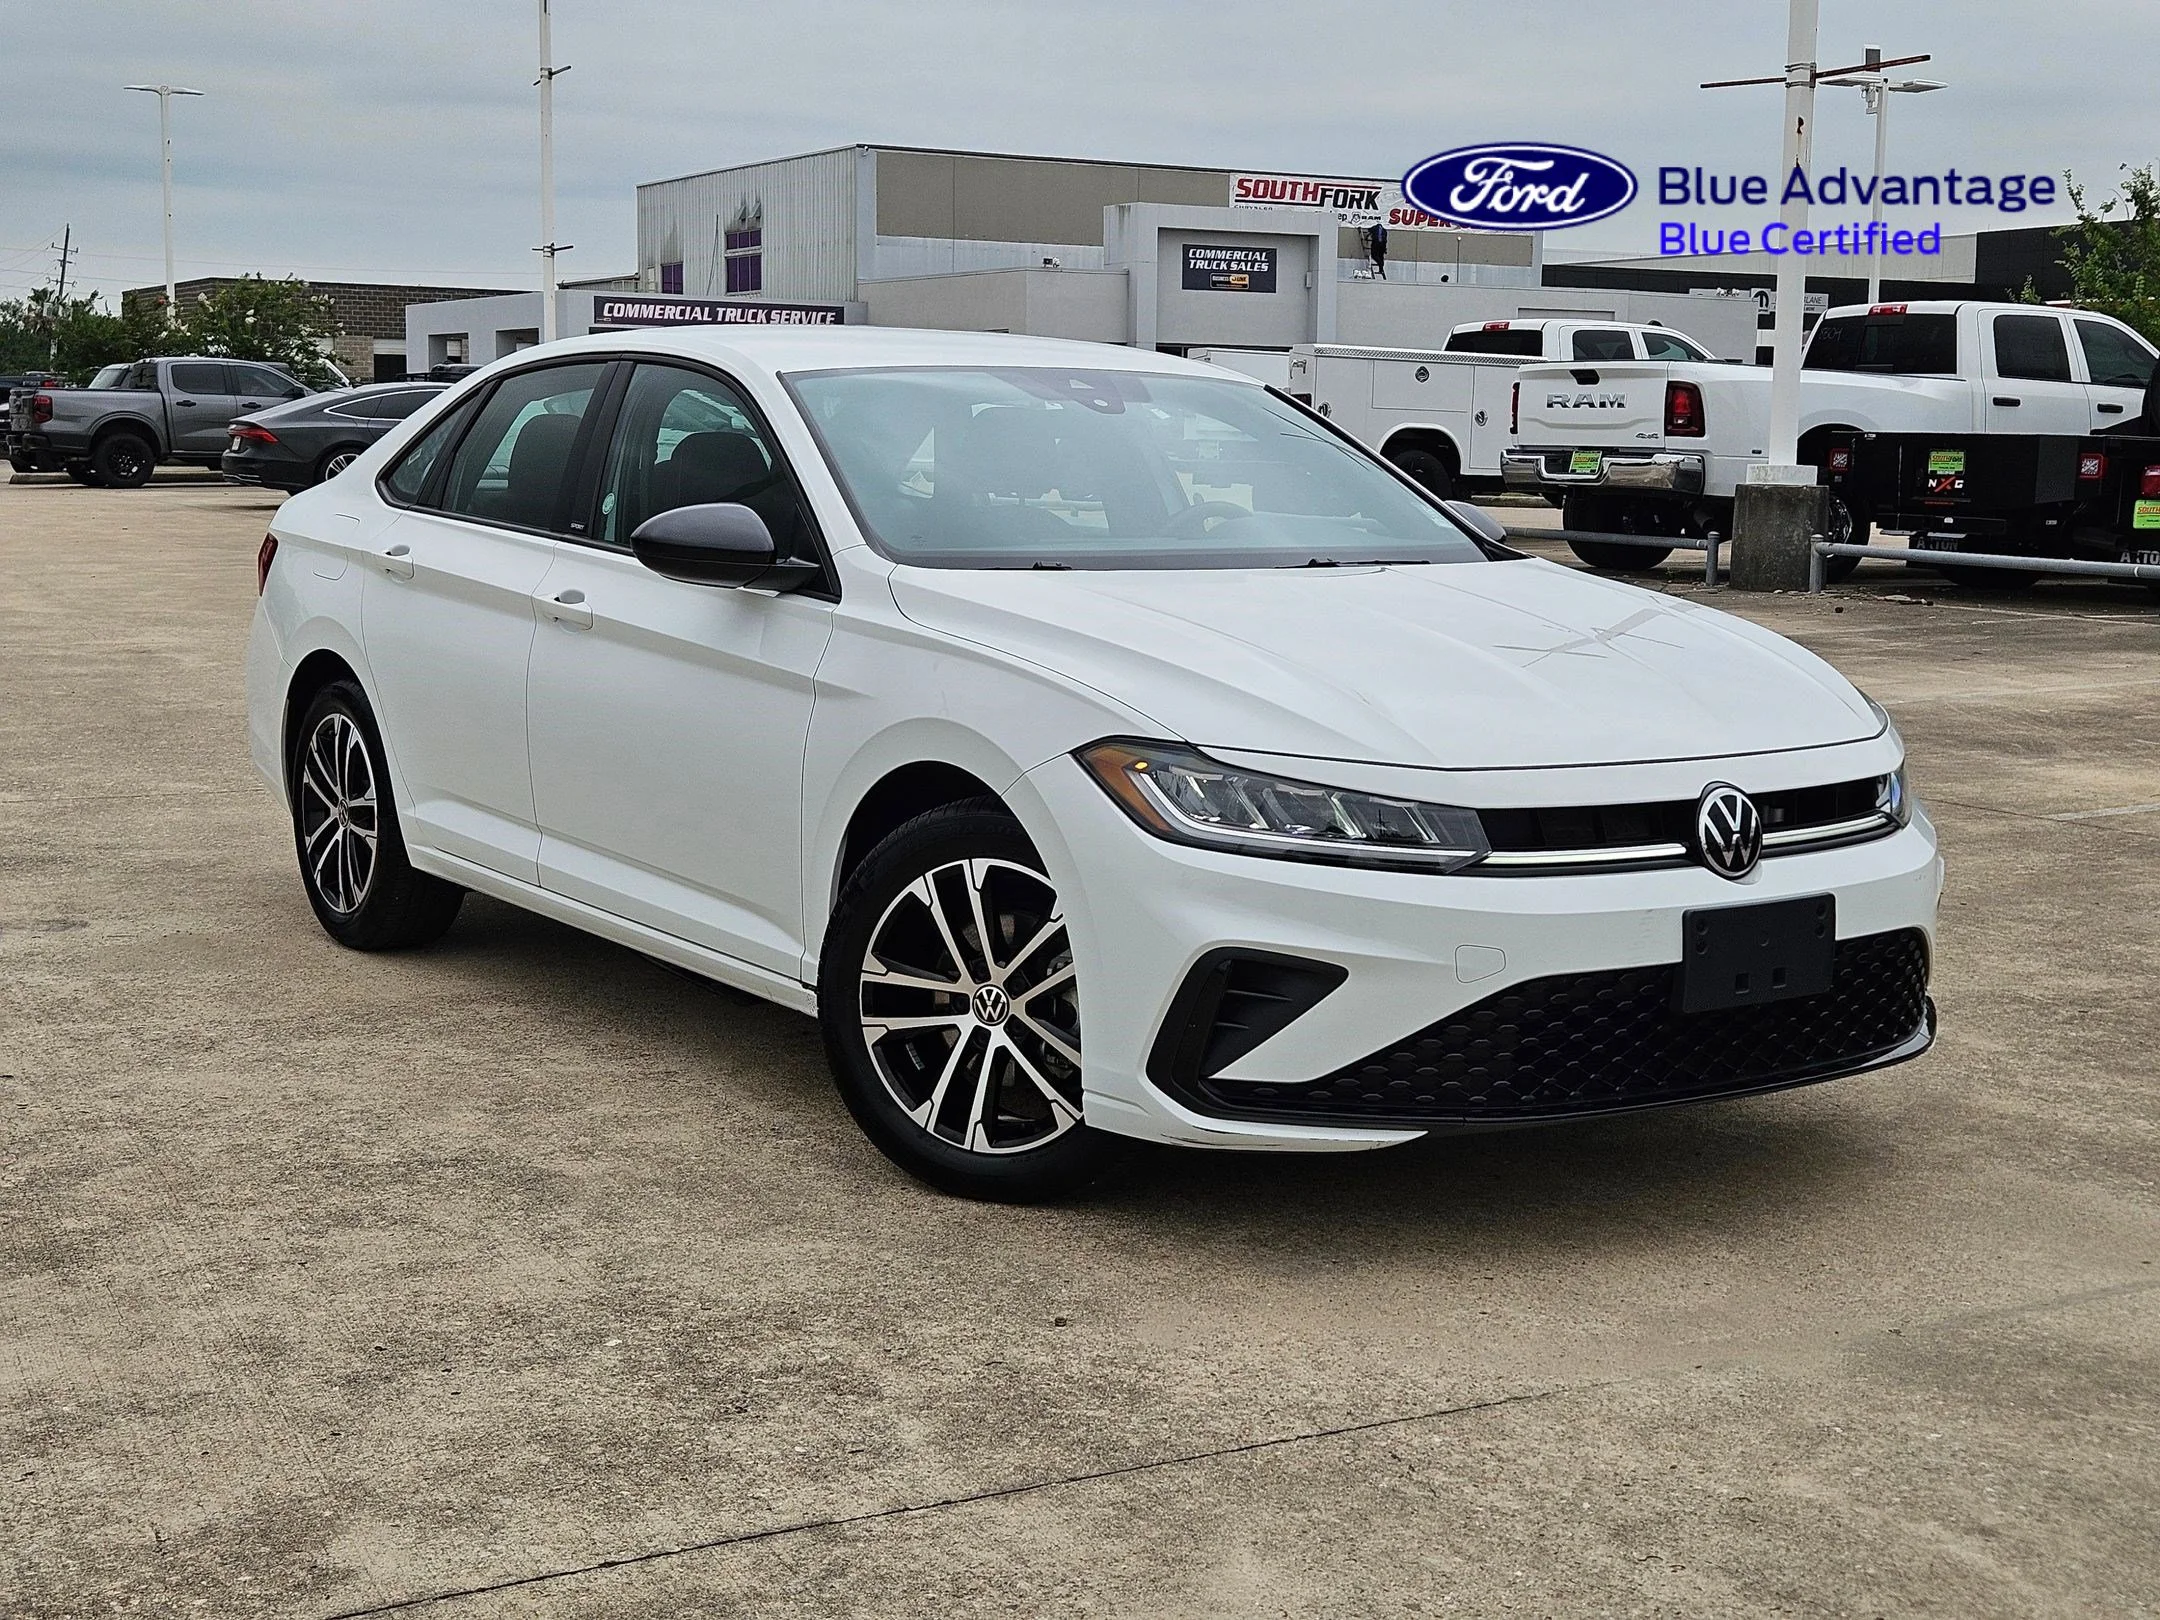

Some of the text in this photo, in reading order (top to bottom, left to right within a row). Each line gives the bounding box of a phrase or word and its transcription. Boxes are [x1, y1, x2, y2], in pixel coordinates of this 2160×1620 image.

[1235, 178, 1382, 210] SOUTHFORK
[1188, 248, 1268, 262] COMMERCIAL
[1189, 259, 1269, 272] TRUCK SALES
[602, 302, 836, 325] COMMERCIAL TRUCK SERVICE
[1546, 392, 1627, 409] RAM
